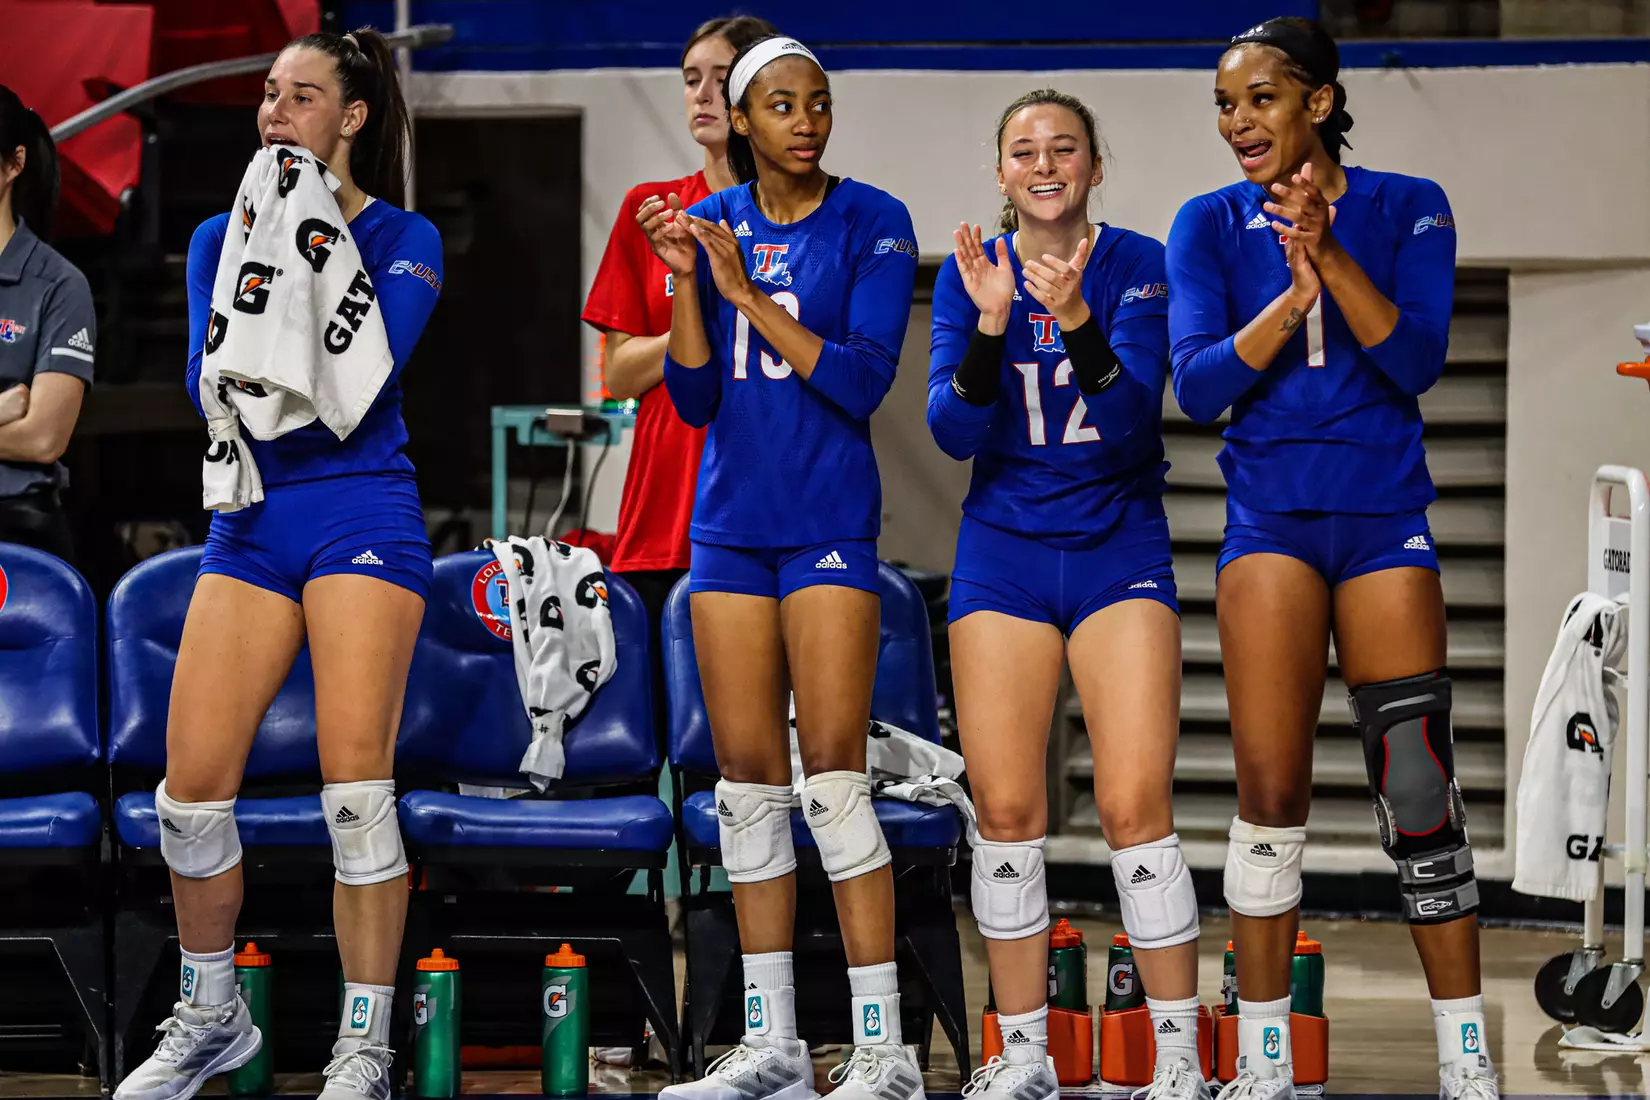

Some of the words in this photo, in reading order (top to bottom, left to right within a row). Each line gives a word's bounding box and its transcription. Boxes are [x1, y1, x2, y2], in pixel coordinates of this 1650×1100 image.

[1246, 221, 1270, 229] adidas
[233, 261, 276, 315] G
[1012, 358, 1102, 447] 12
[1403, 542, 1430, 550] adidas
[352, 557, 384, 566] adidas
[815, 562, 848, 570] adidas
[1250, 848, 1277, 858] adidas
[993, 871, 1020, 879] adidas
[1131, 873, 1157, 884] adidas
[1109, 963, 1134, 996] G
[543, 984, 567, 1018] G
[413, 993, 428, 1025] G
